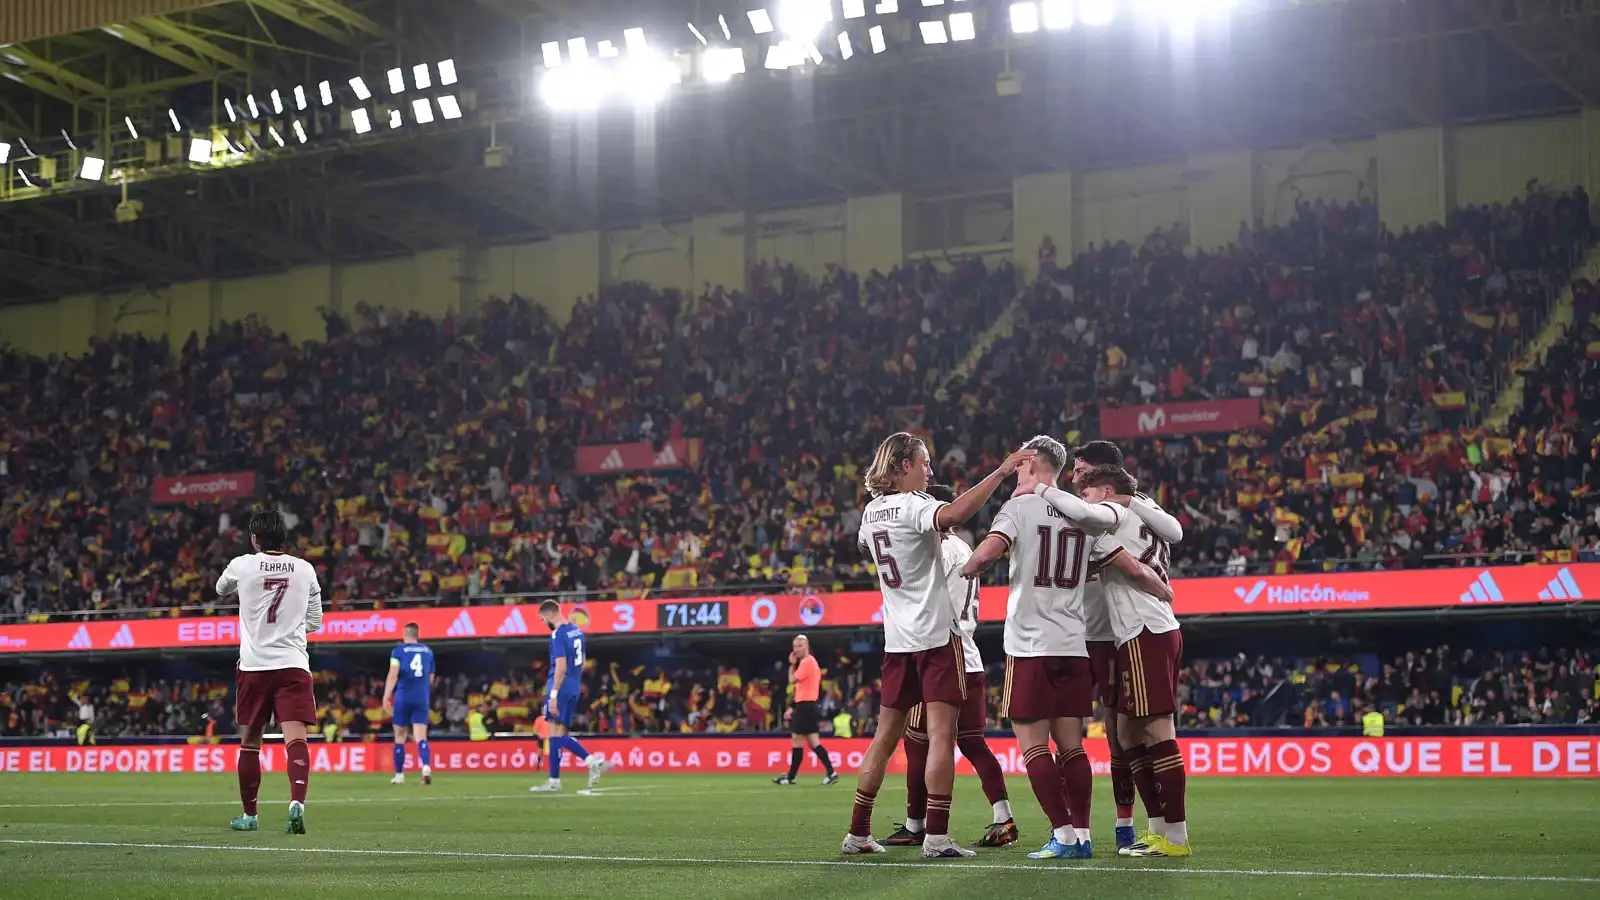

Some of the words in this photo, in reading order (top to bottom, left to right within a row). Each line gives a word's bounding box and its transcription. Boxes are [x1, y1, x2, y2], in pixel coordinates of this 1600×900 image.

[870, 506, 901, 523] LLORENTE
[259, 561, 295, 573] FERRAN
[872, 530, 903, 590] 5
[1034, 525, 1087, 590] 10
[263, 577, 289, 624] 7
[1267, 583, 1335, 604] Halcón
[328, 614, 397, 635] mapfre
[612, 604, 635, 631] 3
[664, 603, 722, 627] 71:44
[751, 598, 777, 627] 0
[178, 620, 240, 641] EBA
[573, 639, 583, 667] 3
[410, 653, 423, 677] 4
[30, 751, 57, 772] EL
[67, 750, 183, 772] DEPORTE
[193, 749, 225, 771] ES
[403, 748, 543, 768] SLECCIÓN
[717, 752, 751, 767] DE
[1190, 742, 1332, 772] BEMOS
[1350, 742, 1441, 773] QUE
[1461, 742, 1512, 772] EL
[1532, 741, 1600, 772] DE
